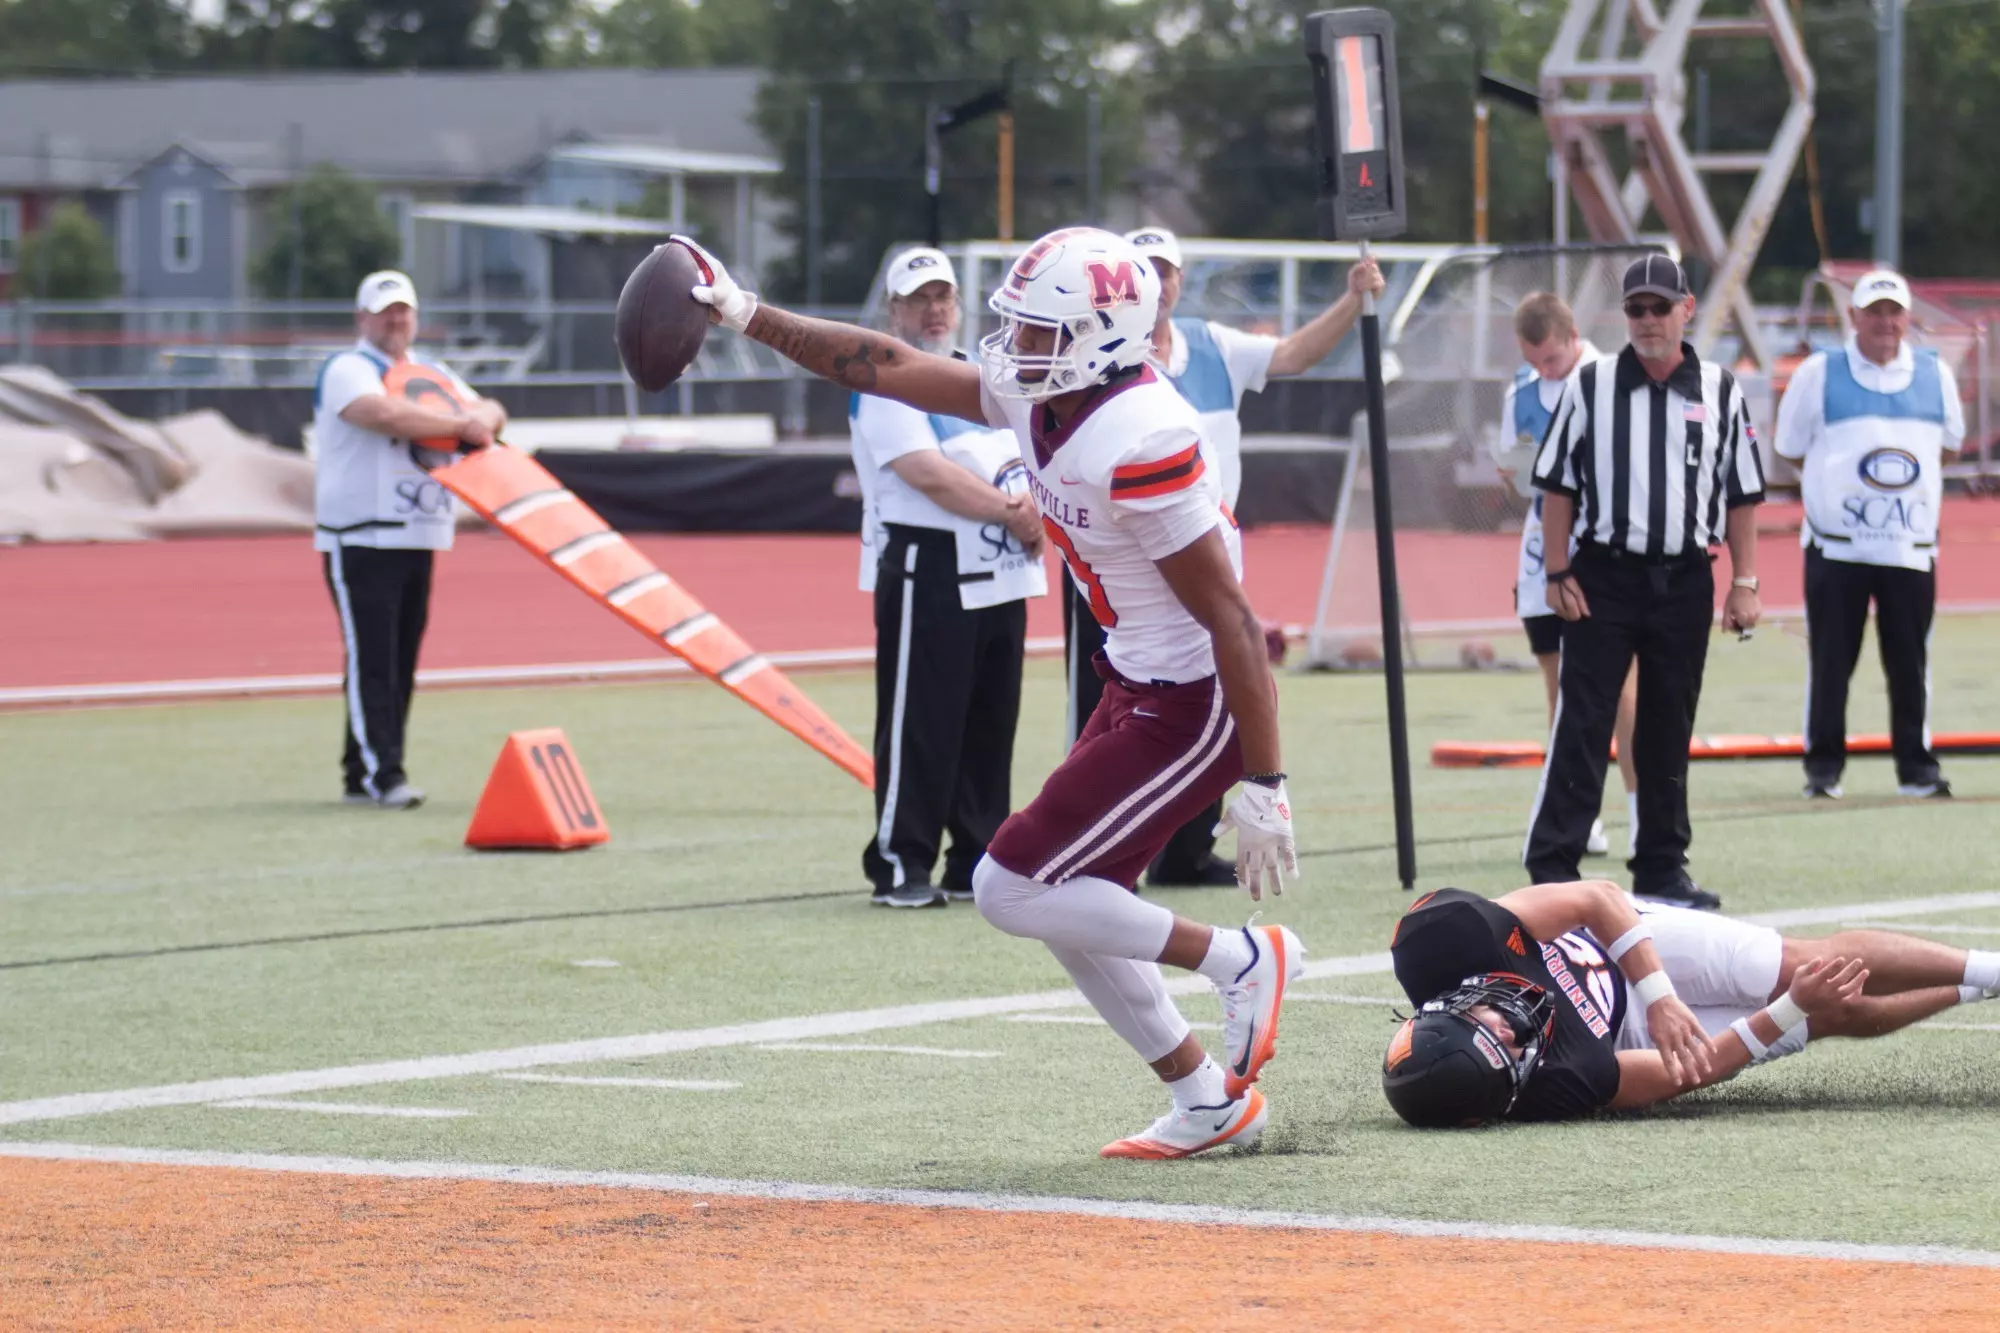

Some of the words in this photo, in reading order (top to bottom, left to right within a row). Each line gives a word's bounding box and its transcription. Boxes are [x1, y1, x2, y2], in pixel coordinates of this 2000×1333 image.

[1085, 260, 1141, 309] M
[1686, 443, 1699, 467] L
[1842, 497, 1927, 534] SCAC
[531, 743, 597, 832] 10
